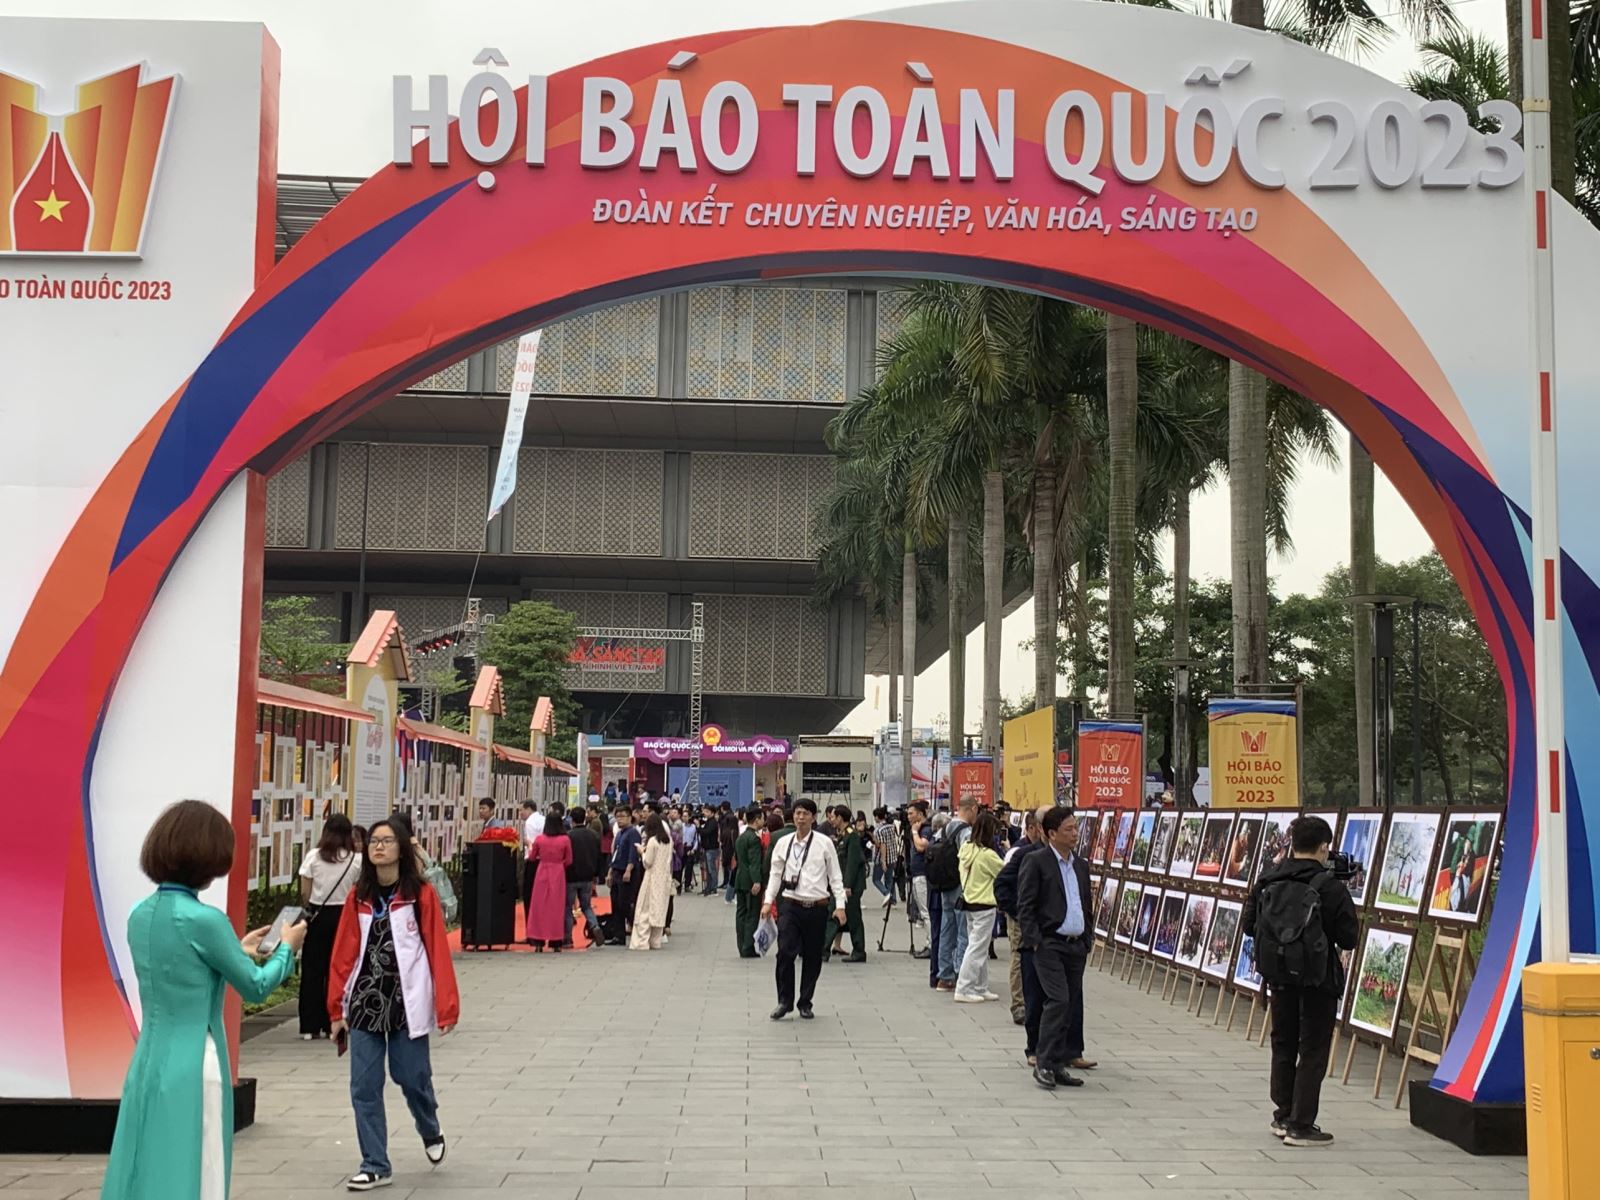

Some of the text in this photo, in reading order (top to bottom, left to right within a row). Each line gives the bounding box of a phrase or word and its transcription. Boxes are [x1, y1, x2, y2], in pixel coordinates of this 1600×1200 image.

[393, 47, 1525, 195] HỘI BÁO TOÀN QUỐC 2023
[593, 182, 1259, 239] ĐOÀN KẾT CHUYÊN NGHIỆP, VĂN HÓA, SÁNG TẠO
[15, 274, 66, 299] TOÀN
[71, 272, 124, 299] QUỐC
[127, 280, 171, 300] 2023
[1109, 764, 1130, 775] BÁO
[1227, 759, 1282, 774] HỘI BÁO
[1225, 774, 1253, 785] TOÀN
[1255, 773, 1285, 786] QUỐC
[1096, 786, 1124, 797] 2023
[1236, 790, 1276, 802] 2023
